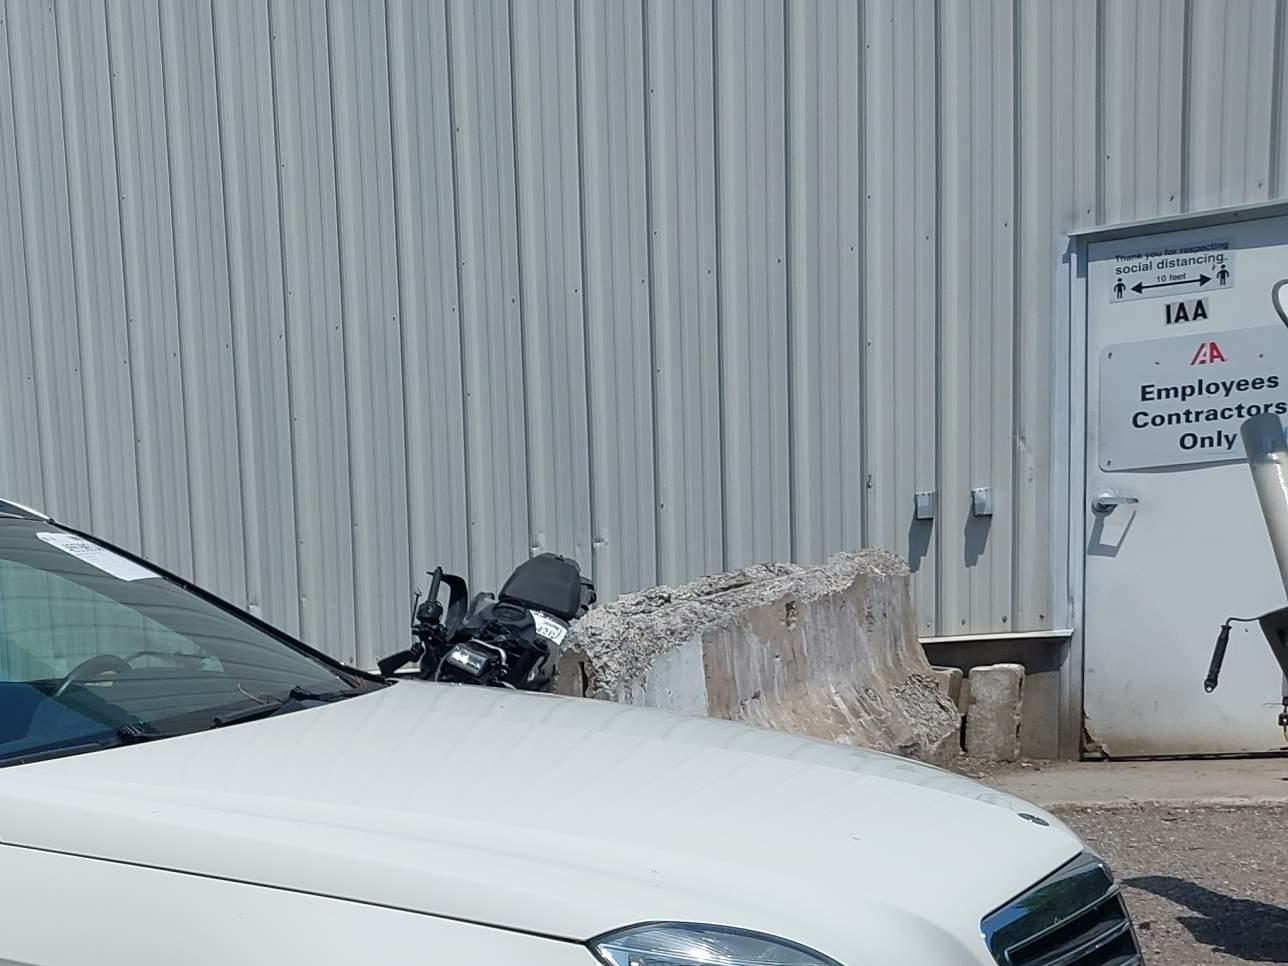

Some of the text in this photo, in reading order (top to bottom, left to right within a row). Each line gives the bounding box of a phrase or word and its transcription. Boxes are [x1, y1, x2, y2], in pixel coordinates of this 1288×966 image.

[1115, 261, 1153, 275] social
[1157, 273, 1187, 283] 10 feet
[1165, 299, 1208, 325] IAA
[1140, 375, 1280, 402] Employees
[1132, 402, 1287, 429] Contractors
[1179, 430, 1238, 450] Only
